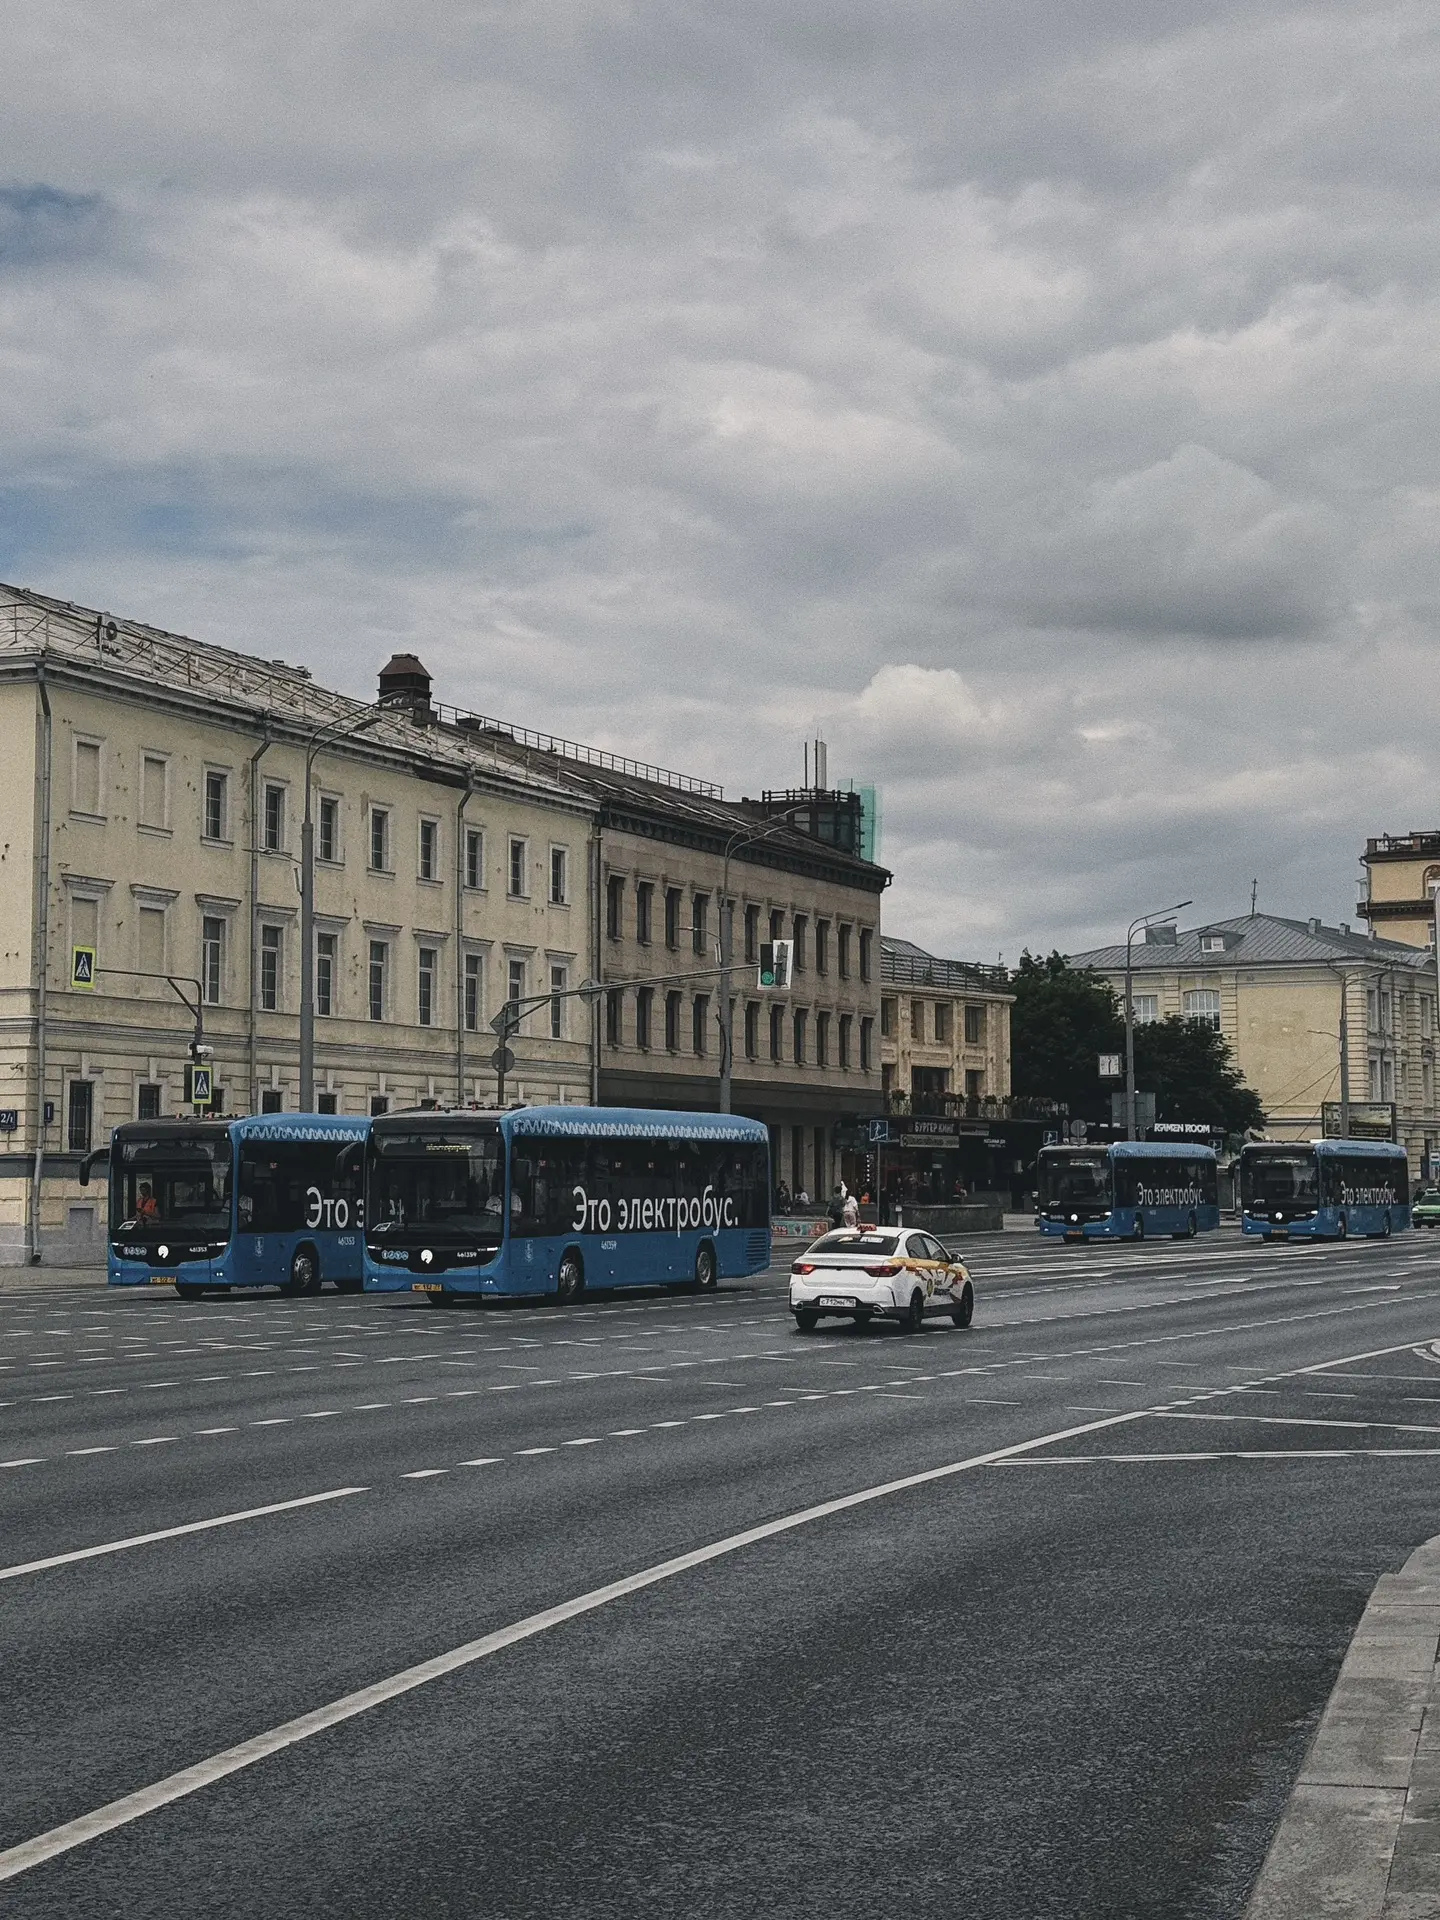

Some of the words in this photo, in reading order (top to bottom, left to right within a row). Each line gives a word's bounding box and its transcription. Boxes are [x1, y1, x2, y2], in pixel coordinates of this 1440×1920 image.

[914, 1121, 938, 1133] БУРГЕР
[1154, 1122, 1183, 1133] RAMEN
[1184, 1123, 1211, 1134] ROOM
[1136, 1181, 1153, 1206] Это
[1155, 1181, 1206, 1210] электробус.
[1340, 1180, 1354, 1205] Это
[305, 1186, 349, 1229] Это
[572, 1185, 612, 1232] Это
[617, 1184, 739, 1239] электробус.
